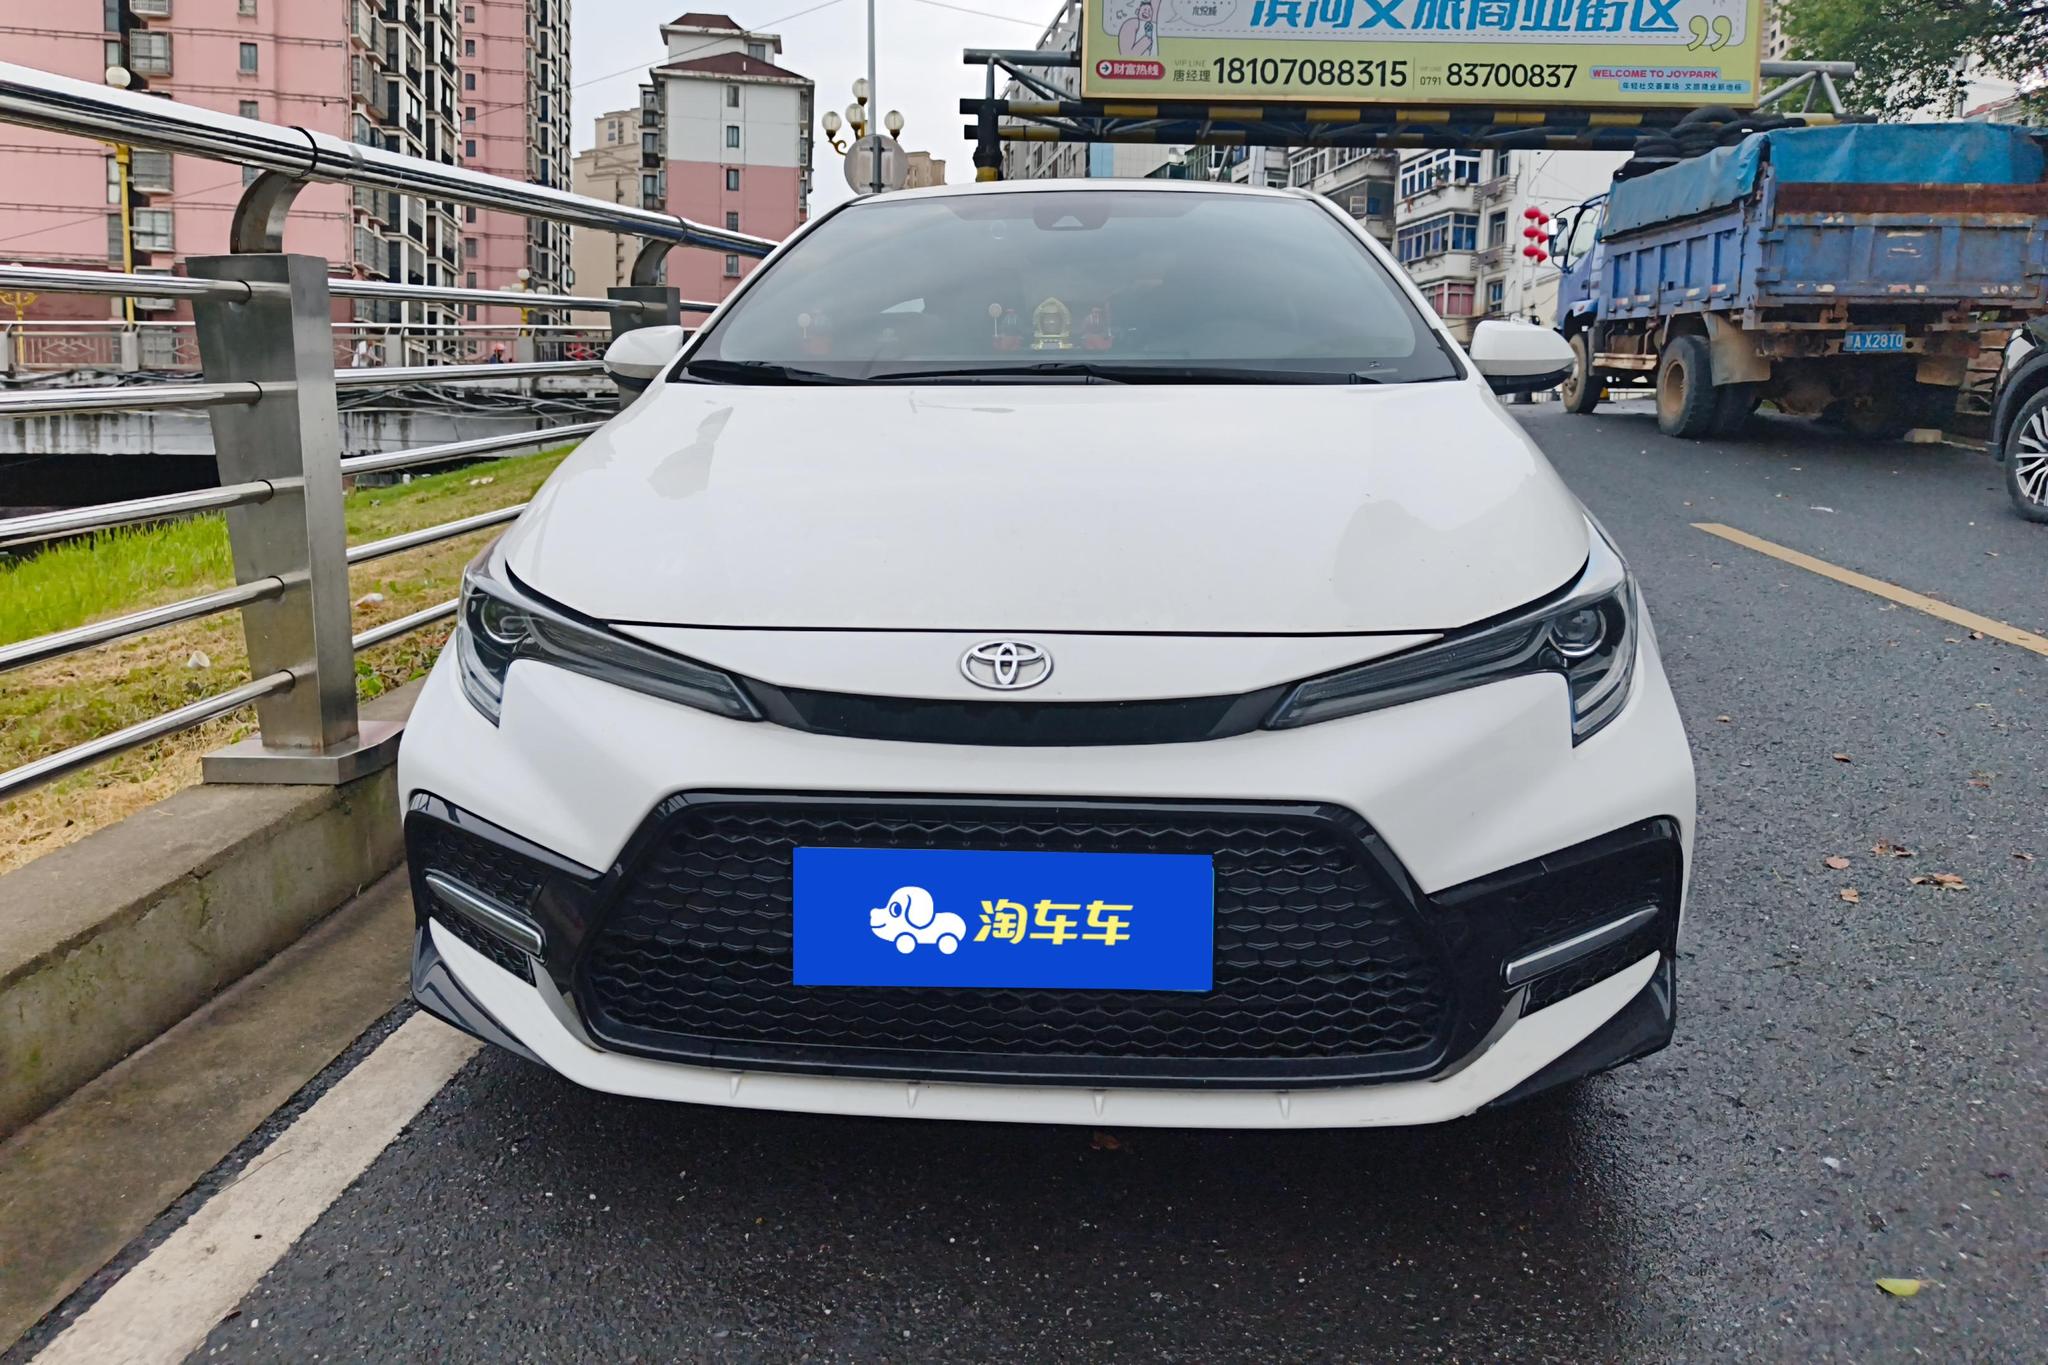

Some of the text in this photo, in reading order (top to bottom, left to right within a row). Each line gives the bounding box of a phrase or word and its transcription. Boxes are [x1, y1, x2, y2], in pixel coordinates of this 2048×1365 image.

[1113, 63, 1159, 76] 财富热线
[1173, 69, 1211, 82] 唐经理
[1213, 57, 1407, 87] 18107088315
[1446, 63, 1578, 88] 83700837
[1593, 69, 1718, 79] WELCOME TO JOYPARK
[1420, 76, 1441, 86] 0791
